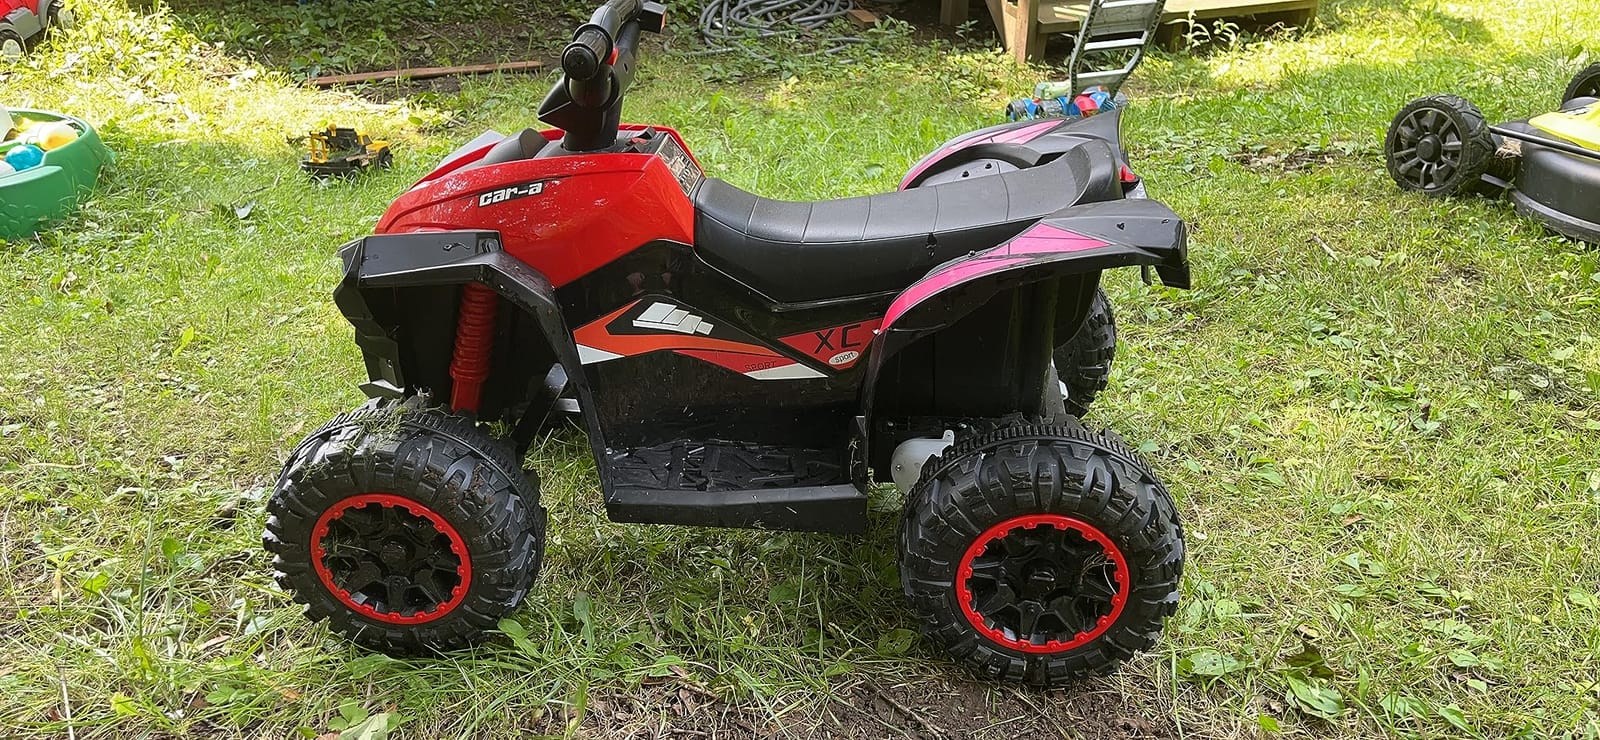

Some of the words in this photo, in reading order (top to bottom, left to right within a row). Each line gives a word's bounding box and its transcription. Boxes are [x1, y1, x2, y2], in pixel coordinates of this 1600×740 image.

[479, 182, 543, 207] car-a
[814, 324, 861, 354] XC
[744, 360, 777, 371] SPORT
[834, 351, 855, 363] sport
